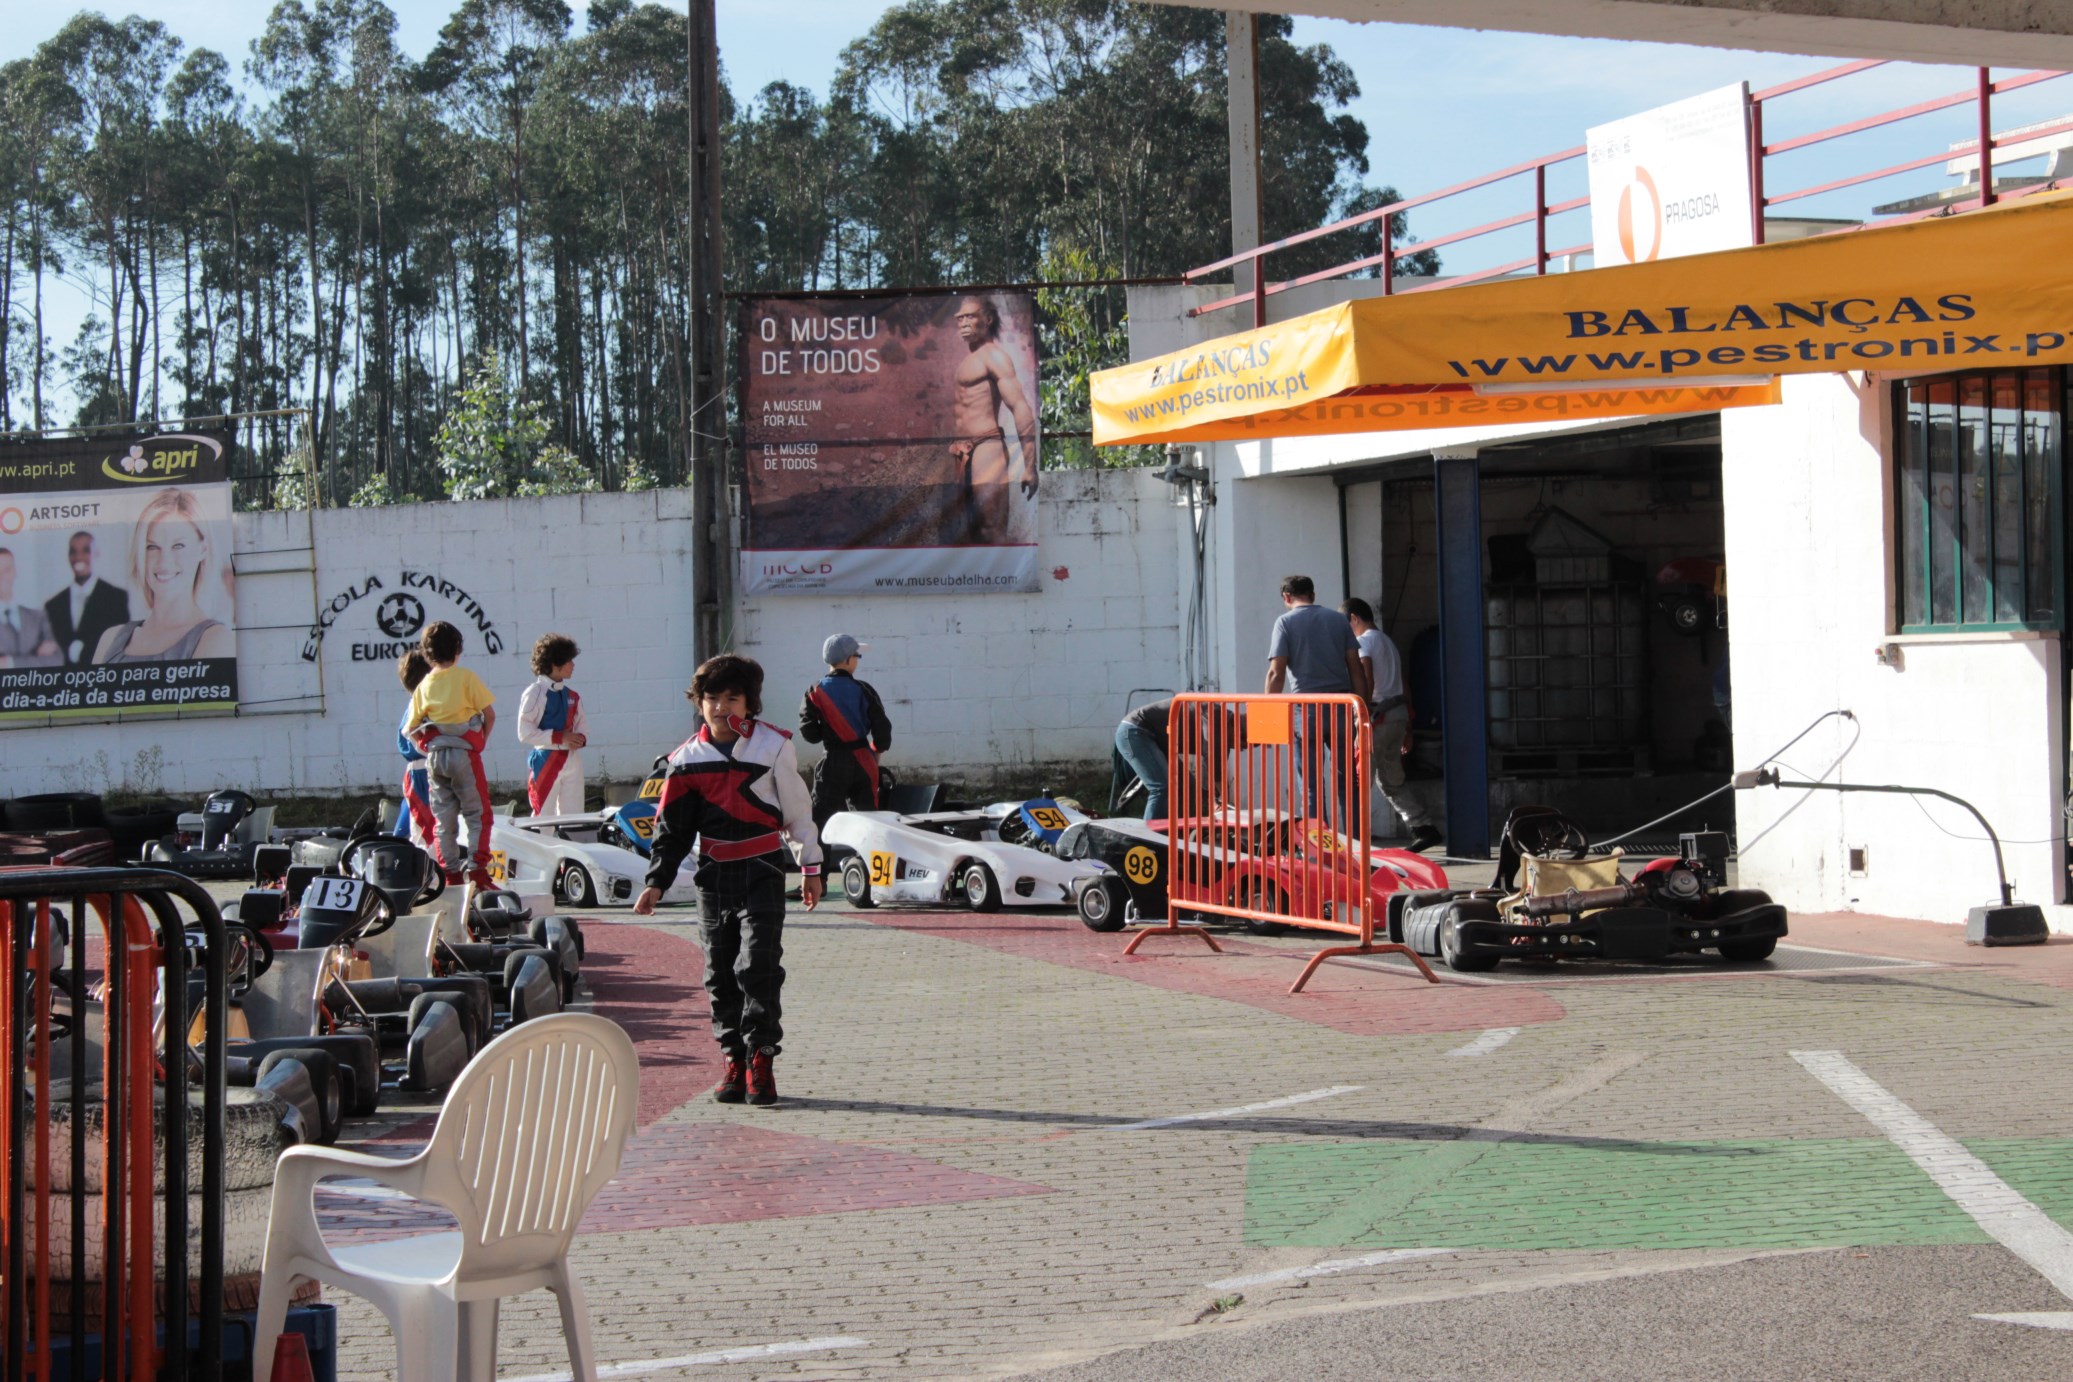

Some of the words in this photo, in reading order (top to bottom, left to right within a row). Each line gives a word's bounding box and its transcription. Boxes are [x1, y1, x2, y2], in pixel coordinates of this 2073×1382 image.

[1665, 191, 1720, 225] PRAGOSA
[761, 317, 776, 342] O
[791, 315, 876, 342] MUSEU
[1563, 294, 1976, 338] BALANÇAS
[761, 350, 791, 375] DE
[799, 348, 881, 374] TODOS
[1149, 339, 1271, 388] BALANÇAS
[1447, 330, 2073, 377] www.pestronix.p
[763, 400, 771, 412] A
[773, 399, 822, 412] MUSEUM
[1124, 370, 1309, 424] www.pestronix.pt
[763, 415, 785, 427] FOR
[788, 414, 808, 426] ALL
[152, 443, 199, 475] apri
[764, 444, 777, 455] EL
[780, 443, 818, 455] MUSEO
[764, 458, 778, 471] DE
[781, 458, 818, 470] TODOS
[29, 503, 100, 520] ARTSOFT
[874, 574, 1018, 587] www.museubatalha.com
[302, 575, 383, 662] ESCOLA
[401, 570, 504, 656] KARTING
[2, 670, 61, 688] melhor
[65, 667, 117, 688] opção
[121, 667, 160, 685] para
[165, 661, 210, 684] gerir
[2, 689, 80, 709] dia-a-dia
[86, 688, 108, 704] da
[113, 689, 146, 703] sua
[151, 685, 231, 704] empresa
[208, 802, 234, 814] 31
[1034, 809, 1070, 828] 94
[872, 854, 892, 886] 94
[908, 868, 931, 879] HEV
[1128, 853, 1155, 879] 98
[316, 879, 356, 909] 13
